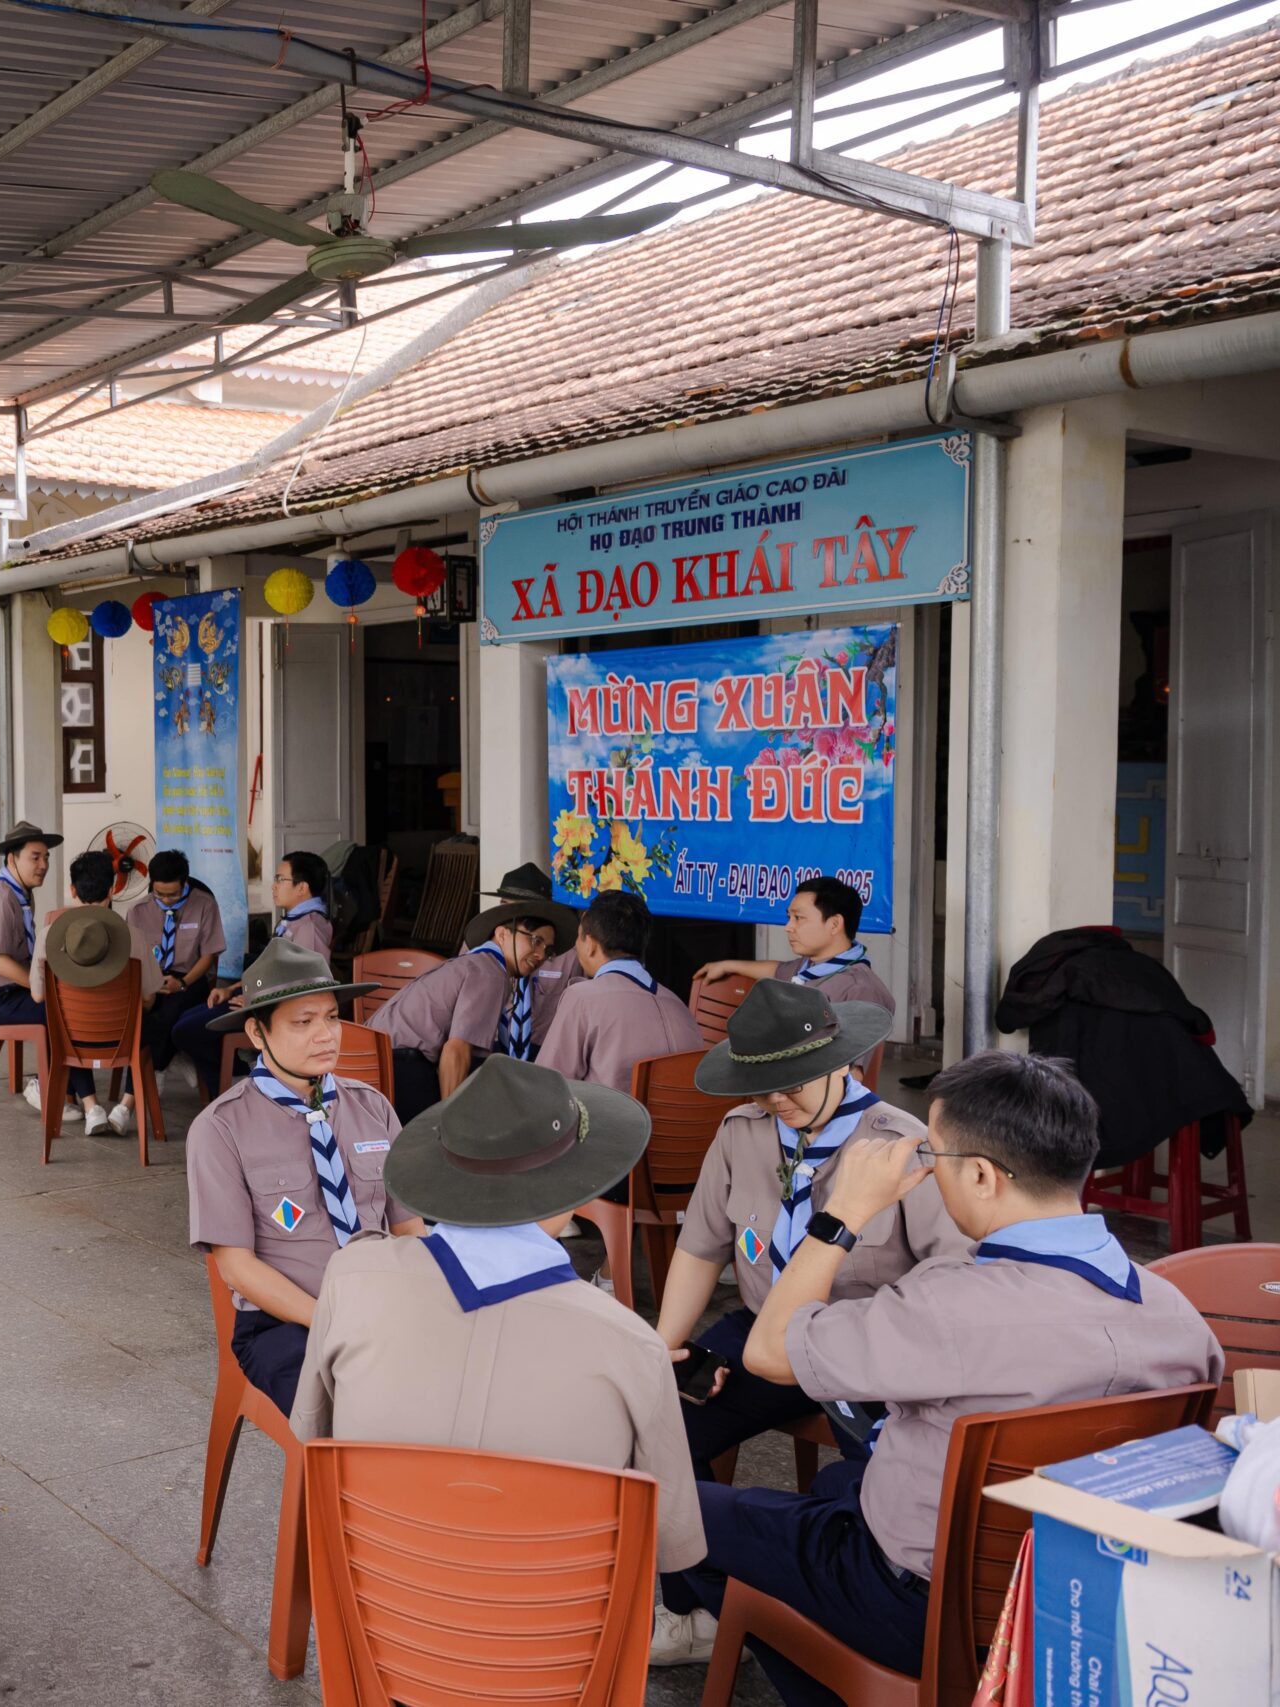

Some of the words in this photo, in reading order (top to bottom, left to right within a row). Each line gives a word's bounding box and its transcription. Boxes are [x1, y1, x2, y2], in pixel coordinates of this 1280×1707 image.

[557, 512, 583, 536] HỘI
[587, 506, 639, 527] THÁNH
[716, 482, 760, 506] GIÁO
[766, 476, 807, 497] CAO
[813, 466, 847, 490] ĐÀI
[590, 532, 613, 553] HỌ
[619, 524, 656, 549] ĐẠO
[661, 513, 724, 540] TRUNG
[731, 501, 801, 530] THÀNH
[511, 563, 564, 621] XÃ
[576, 560, 660, 621] ĐẠO
[671, 529, 797, 604] KHÁI
[813, 515, 918, 589] TÂY
[566, 672, 698, 737] MỪNG
[713, 658, 869, 732] XUÂN
[566, 755, 733, 822] THÁNH
[746, 752, 864, 823] ĐỨC
[674, 848, 695, 894] ẤT
[697, 862, 717, 902] TỴ
[728, 863, 755, 904] ĐẠI
[757, 865, 791, 906] ĐẠO
[1070, 1578, 1083, 1608] Cho
[1233, 1569, 1252, 1601] 24
[1070, 1611, 1083, 1639] môi
[1088, 1656, 1102, 1694] Chai
